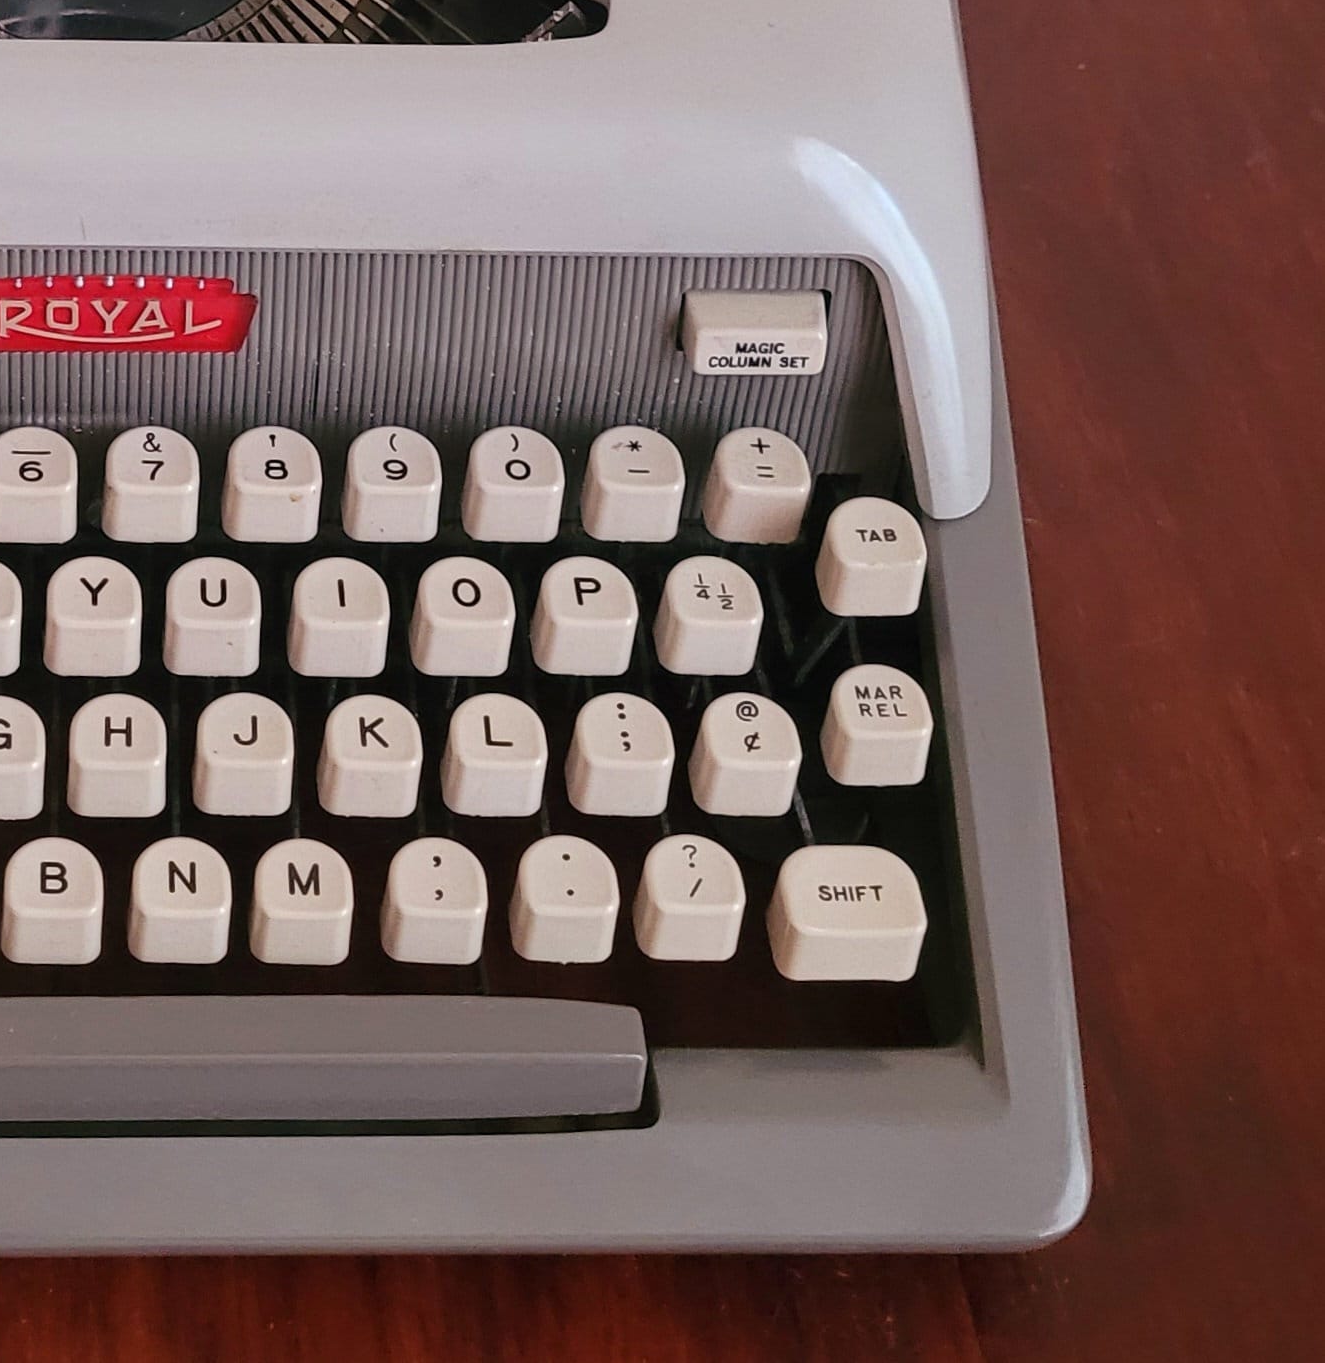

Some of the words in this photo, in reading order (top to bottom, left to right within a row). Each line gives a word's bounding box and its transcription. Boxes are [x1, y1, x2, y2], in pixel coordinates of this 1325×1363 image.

[735, 342, 785, 355] MAGIC
[708, 356, 772, 368] COLUMN
[779, 356, 810, 369] SET
[143, 432, 163, 453] &
[389, 433, 397, 453] (
[510, 433, 520, 453] )
[750, 437, 771, 455] +
[18, 460, 44, 483] 6
[141, 459, 165, 481] 7
[264, 459, 289, 480] 8
[382, 459, 409, 481] 9
[504, 459, 532, 481] 0
[755, 465, 775, 479] =
[855, 528, 898, 543] TAB
[79, 577, 109, 607] Y
[200, 578, 228, 608] U
[337, 578, 346, 608] I
[451, 577, 482, 608] O
[573, 576, 602, 606] P
[854, 685, 903, 700] MAR
[735, 700, 760, 722] @
[858, 703, 908, 718] REL
[104, 716, 133, 748] H
[233, 715, 258, 746] J
[358, 716, 389, 749] K
[483, 715, 514, 747] L
[743, 731, 761, 753] ¢
[681, 844, 698, 869] ?
[40, 861, 69, 895] B
[168, 860, 197, 894] N
[287, 862, 321, 896] M
[689, 878, 703, 898] /
[818, 885, 883, 902] SHIFT
